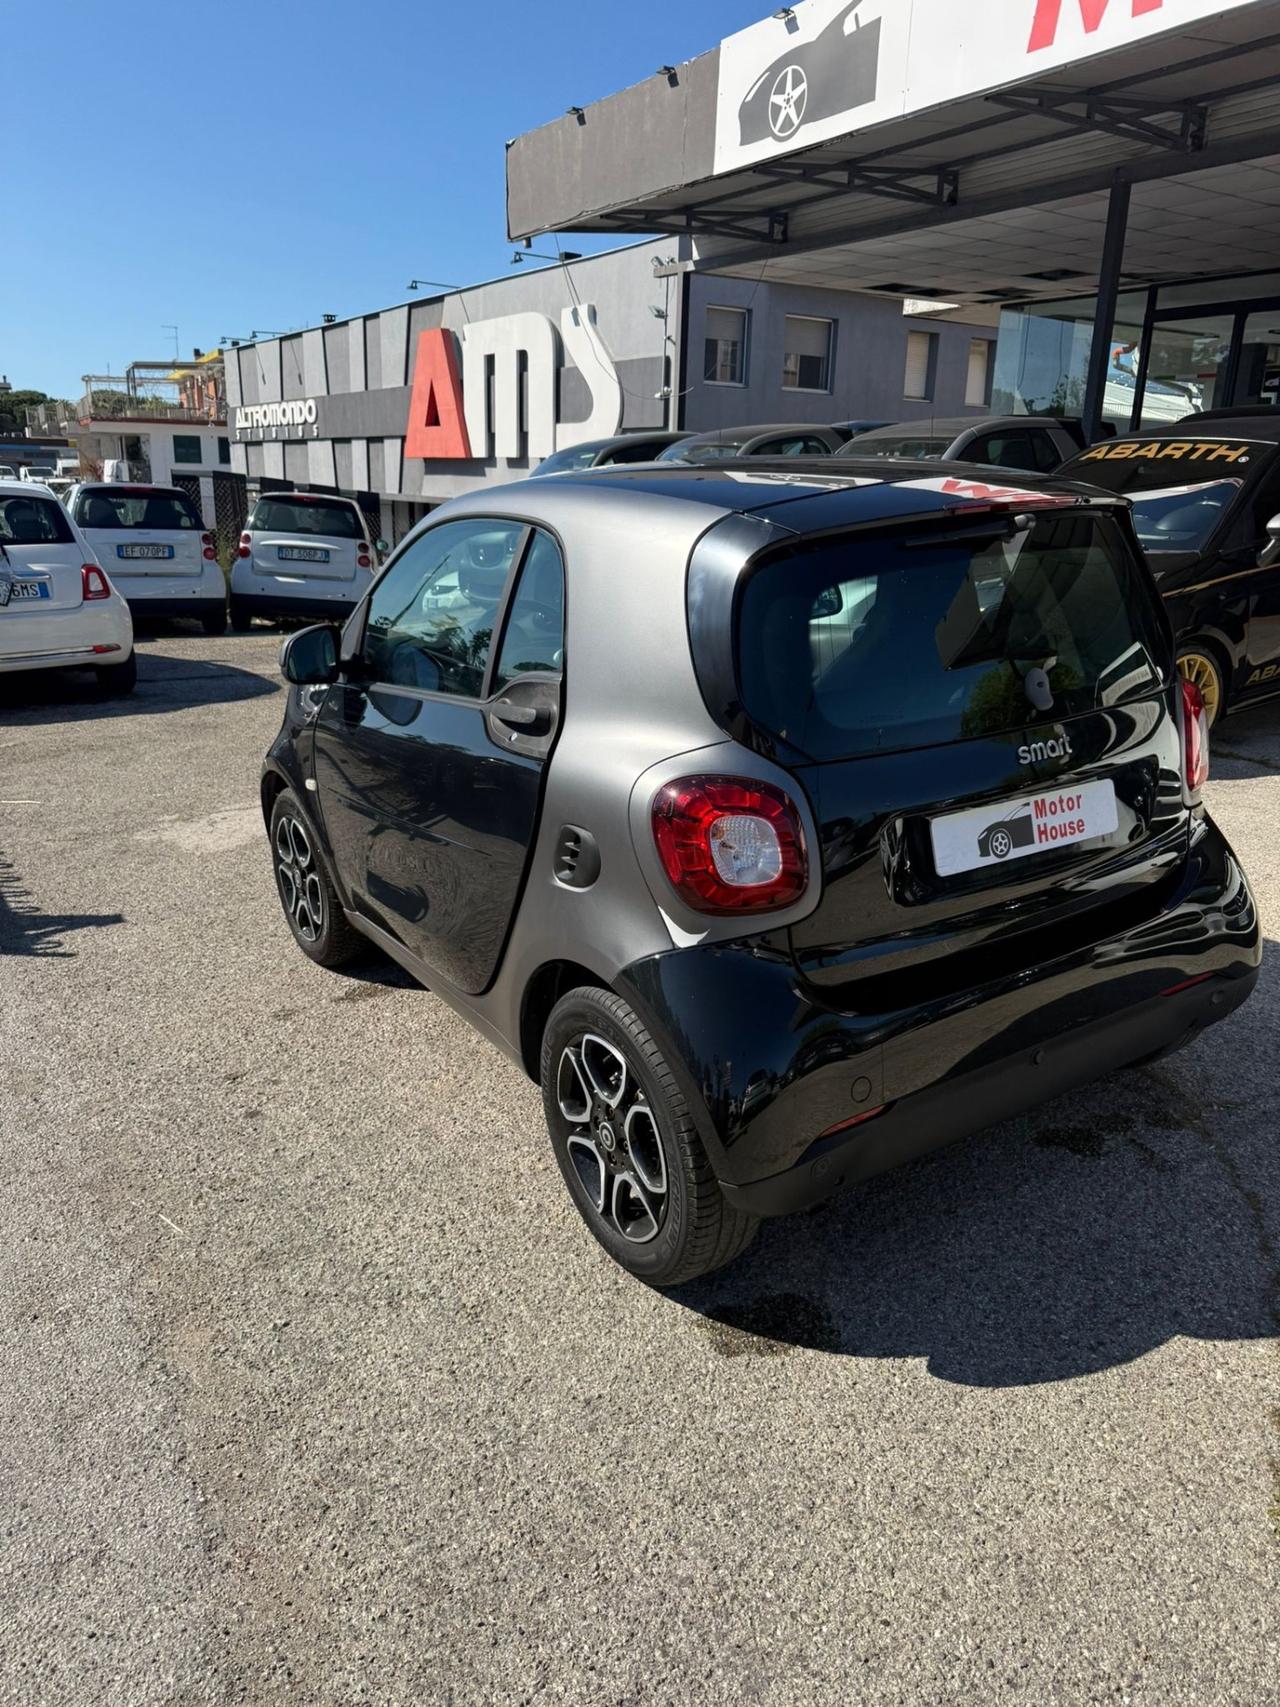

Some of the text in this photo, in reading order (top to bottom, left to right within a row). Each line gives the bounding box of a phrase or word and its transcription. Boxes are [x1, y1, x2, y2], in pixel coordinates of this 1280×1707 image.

[235, 399, 317, 428] ALTROMONDO
[1079, 443, 1249, 463] ABARTH
[124, 545, 137, 557] EF
[1018, 733, 1073, 764] smart
[1033, 794, 1082, 819] Motor
[1036, 819, 1086, 844] House
